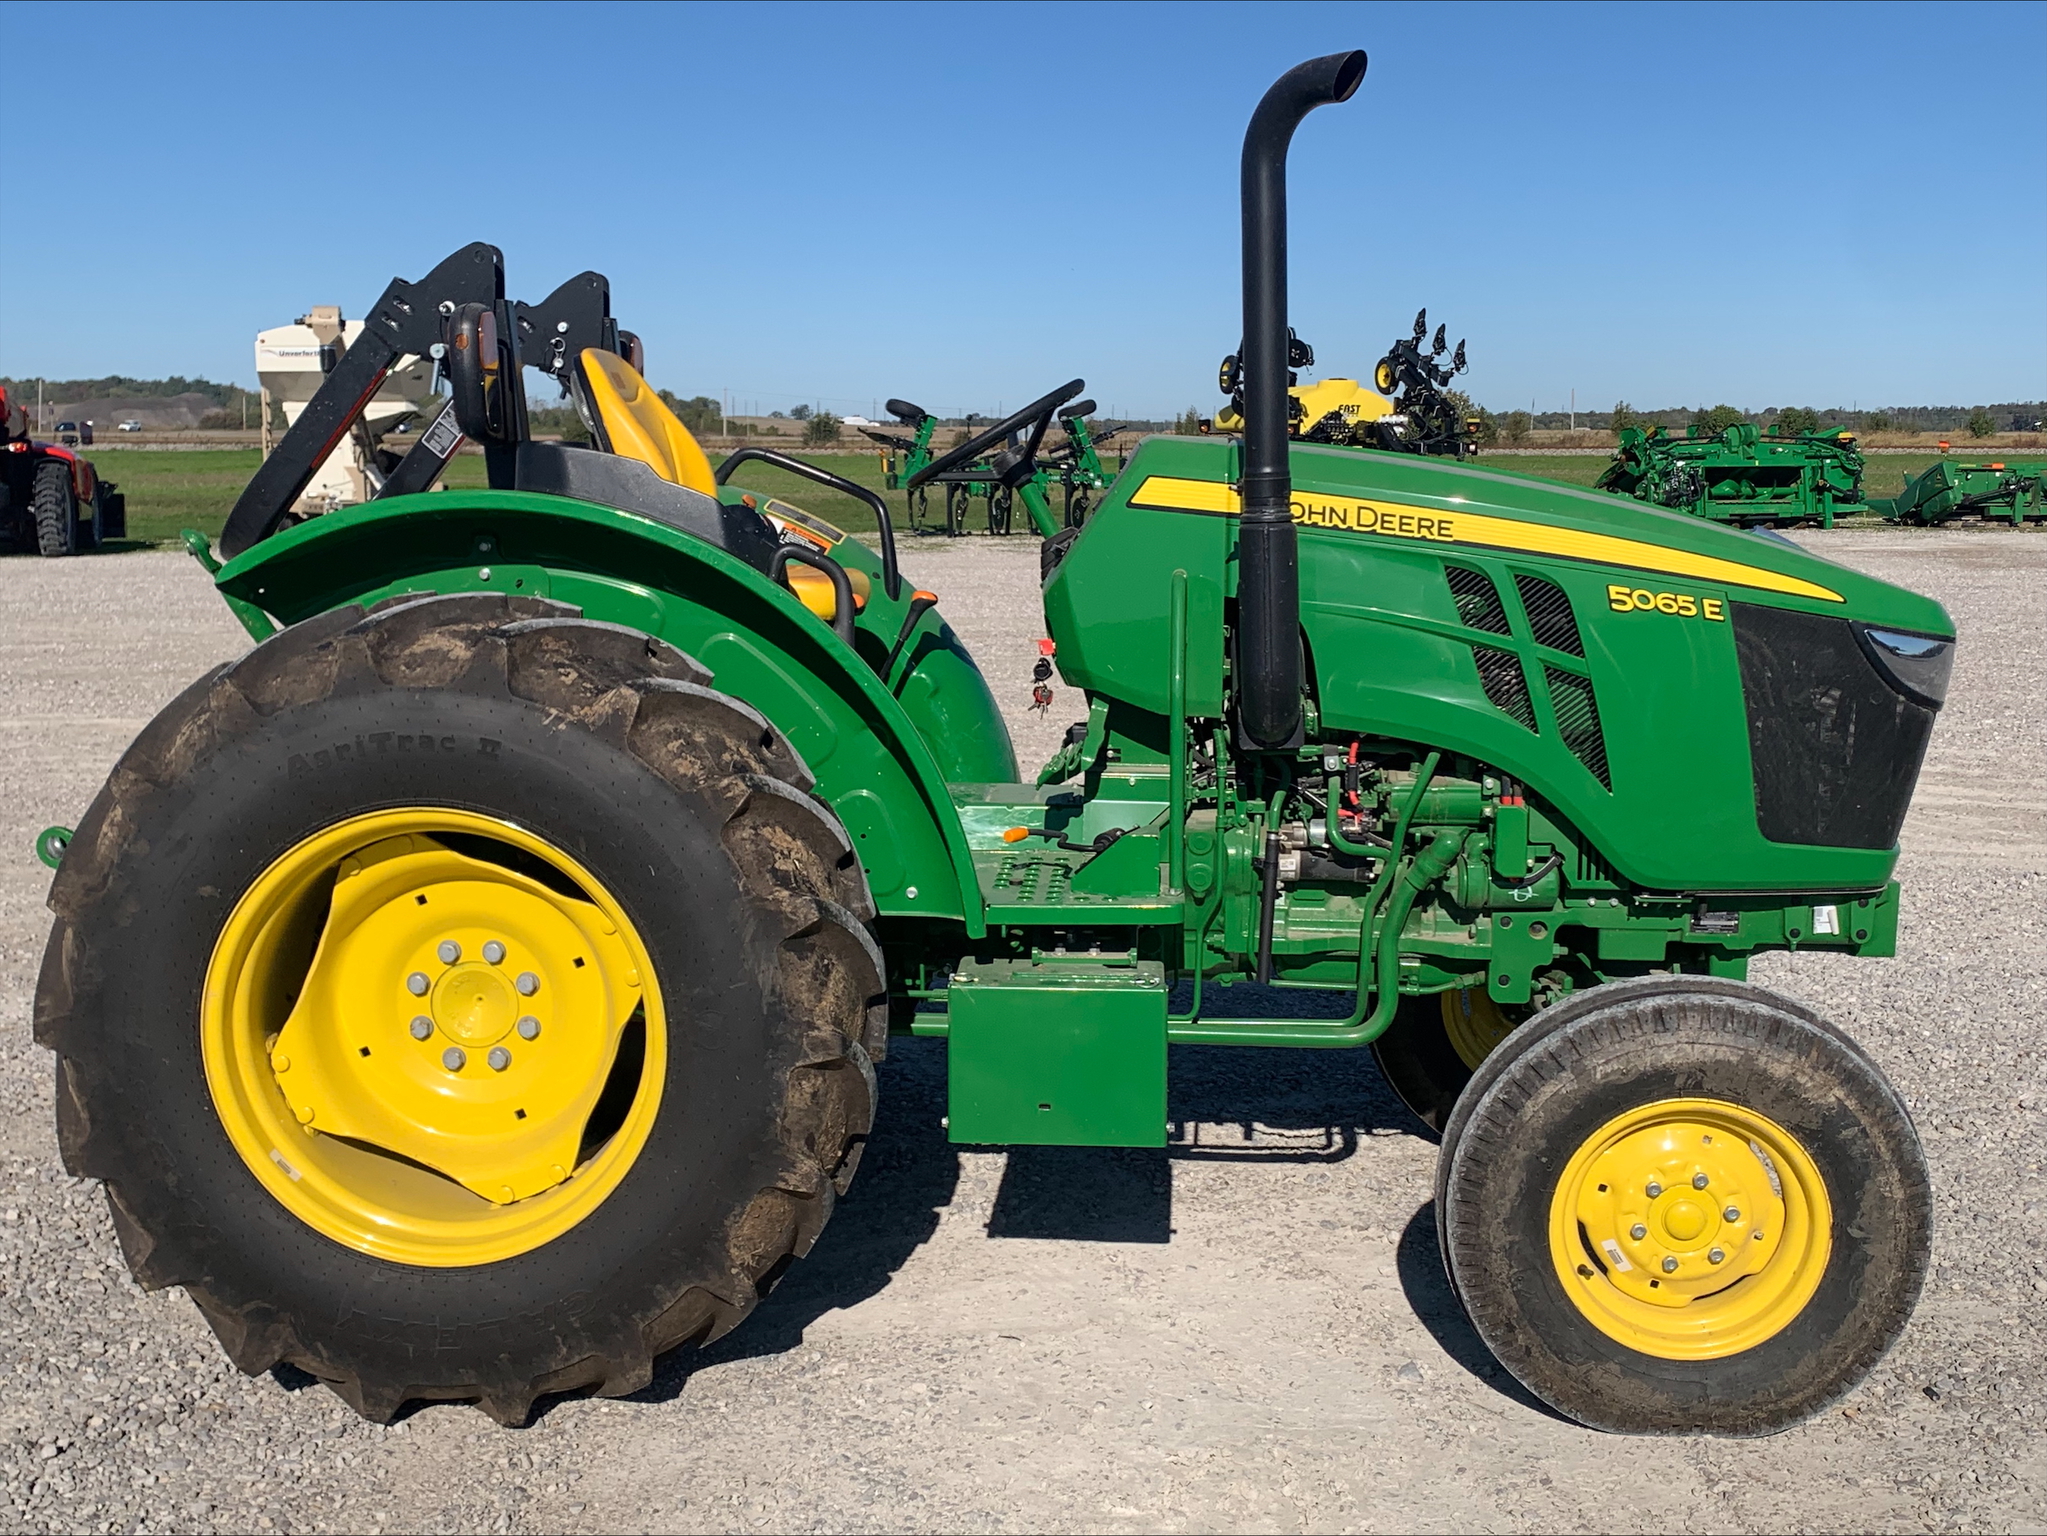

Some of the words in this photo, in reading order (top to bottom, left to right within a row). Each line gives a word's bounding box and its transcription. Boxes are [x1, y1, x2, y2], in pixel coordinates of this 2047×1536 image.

[1337, 404, 1362, 415] FAST
[1290, 502, 1348, 525] OHN
[1356, 505, 1454, 538] DEERE
[1606, 584, 1698, 617] 5065
[1701, 597, 1725, 622] E
[287, 730, 456, 781] AgriTrac
